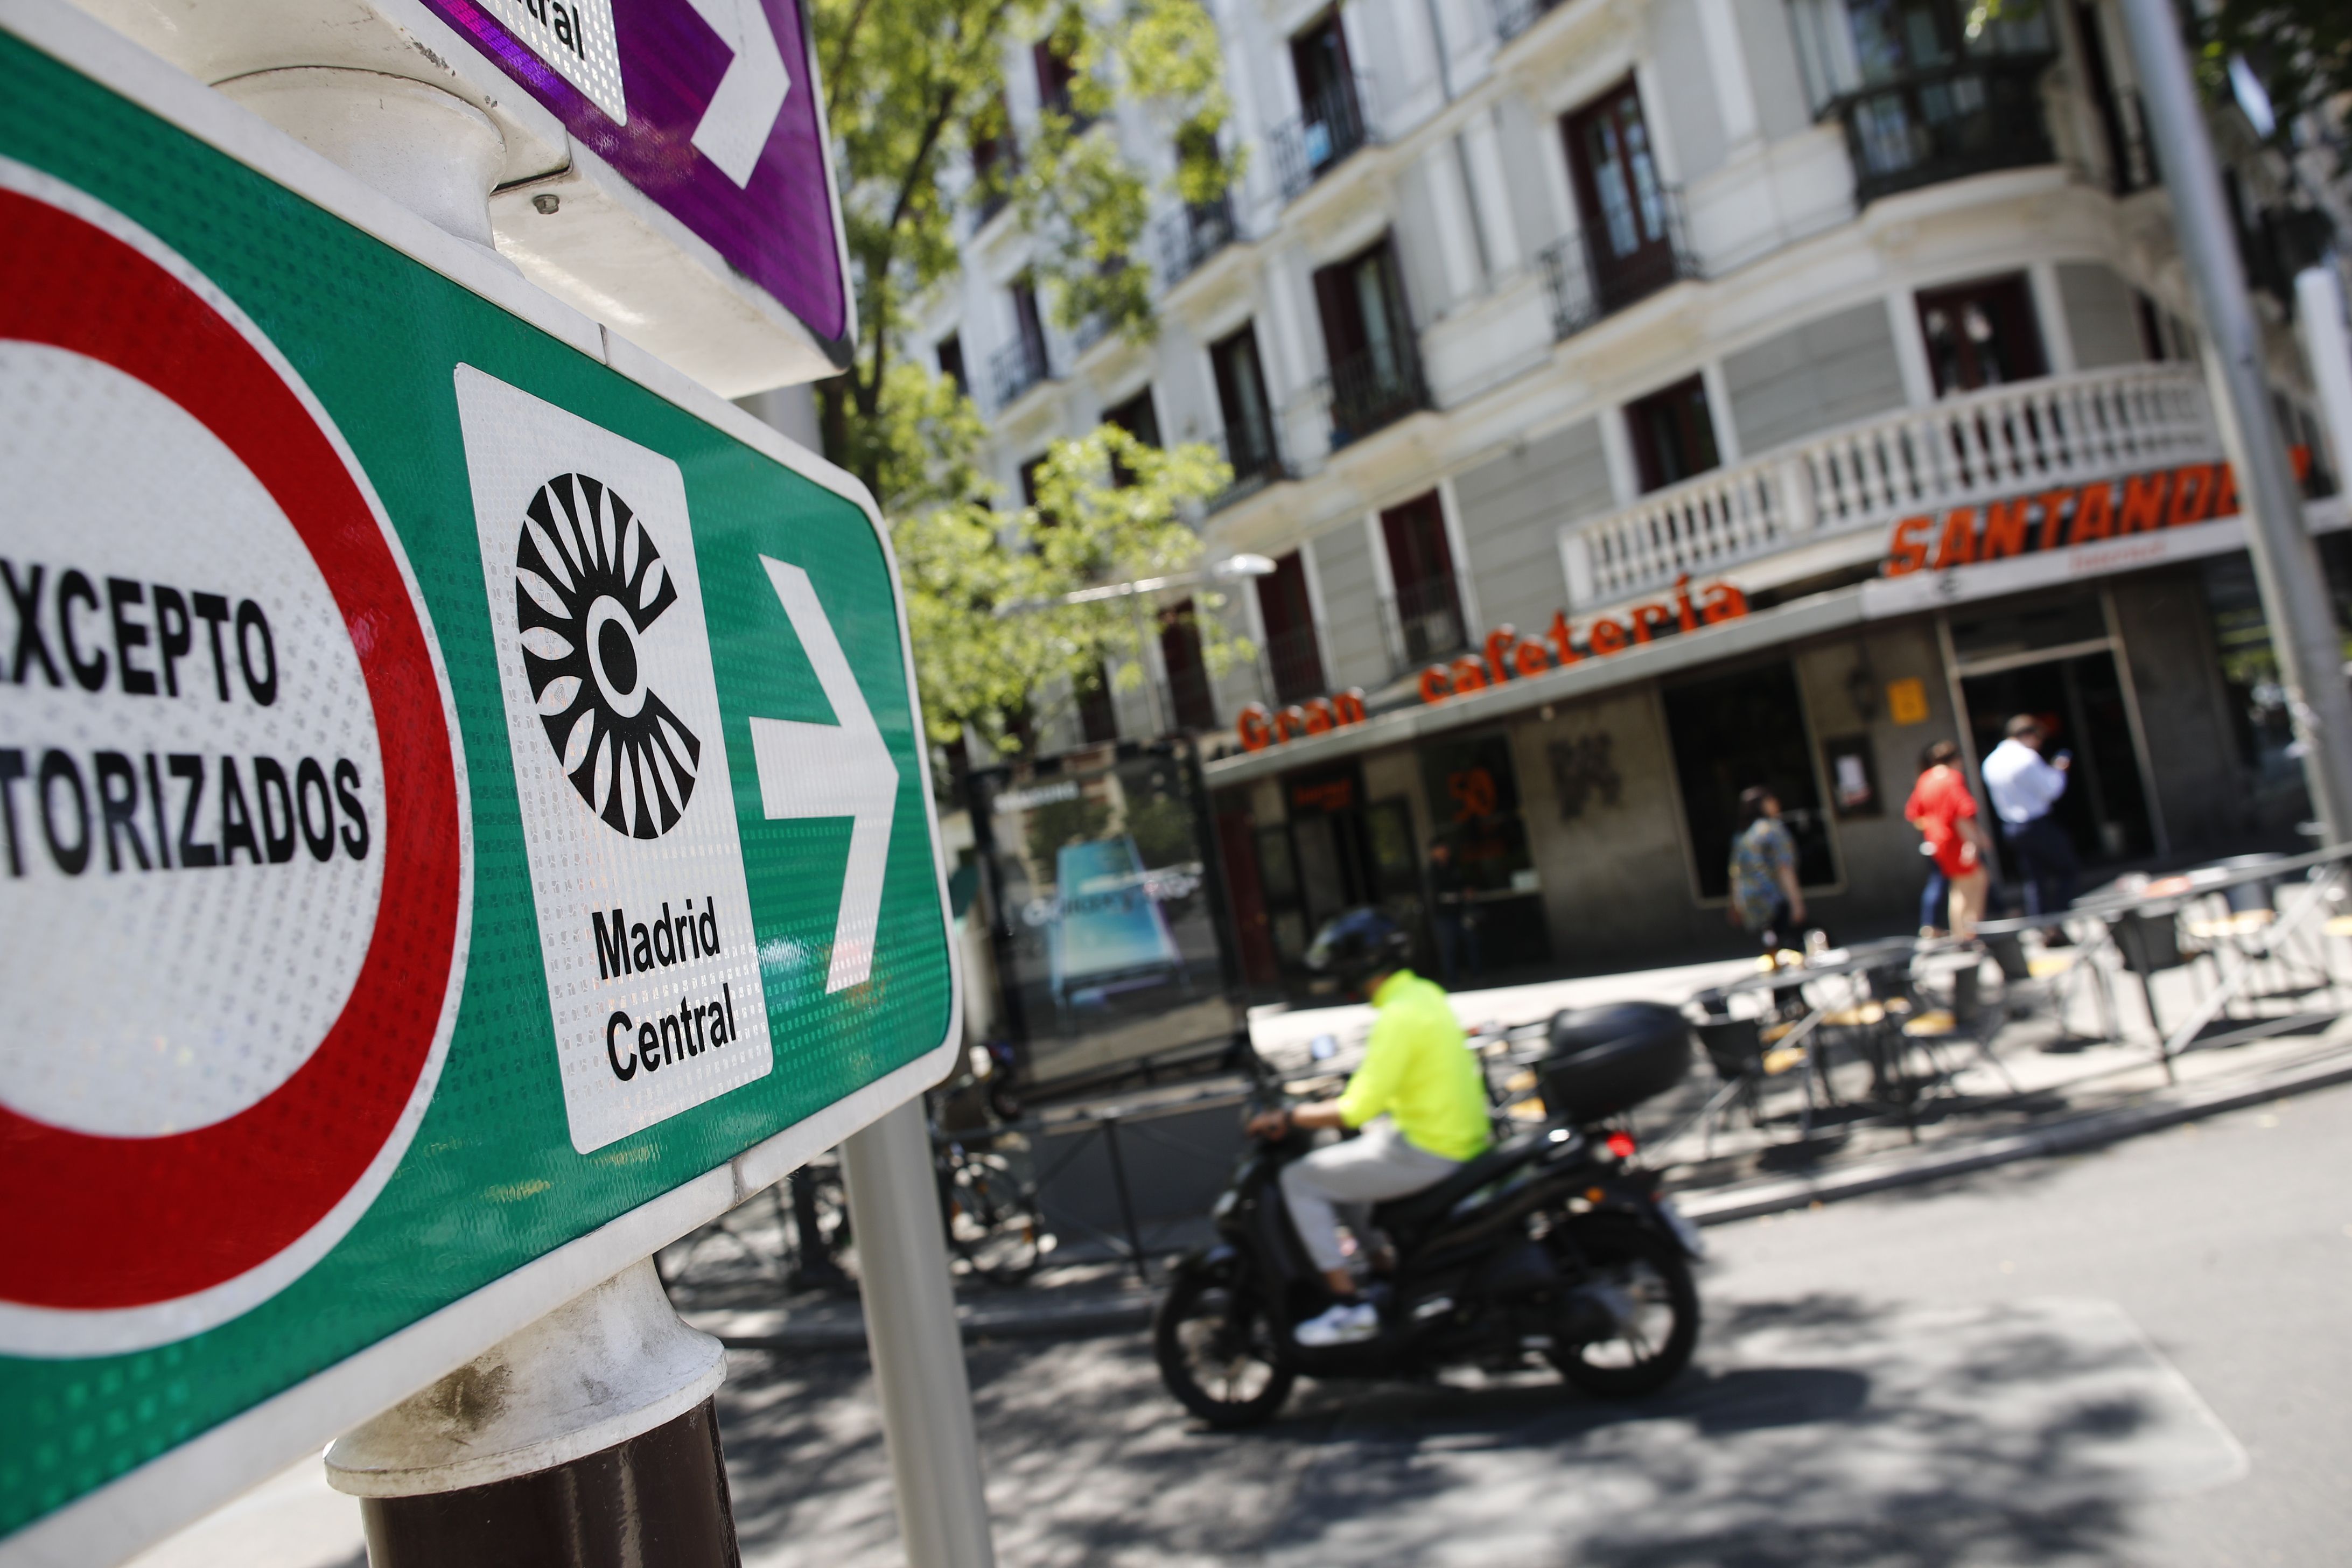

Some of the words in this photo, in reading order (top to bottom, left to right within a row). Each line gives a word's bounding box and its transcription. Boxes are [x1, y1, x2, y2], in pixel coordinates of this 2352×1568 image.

[0, 557, 277, 706] XCEPTO
[1237, 689, 1366, 754] Gran
[1419, 573, 1749, 706] cafeteria
[592, 896, 720, 979] Madrid
[607, 983, 736, 1081] Central
